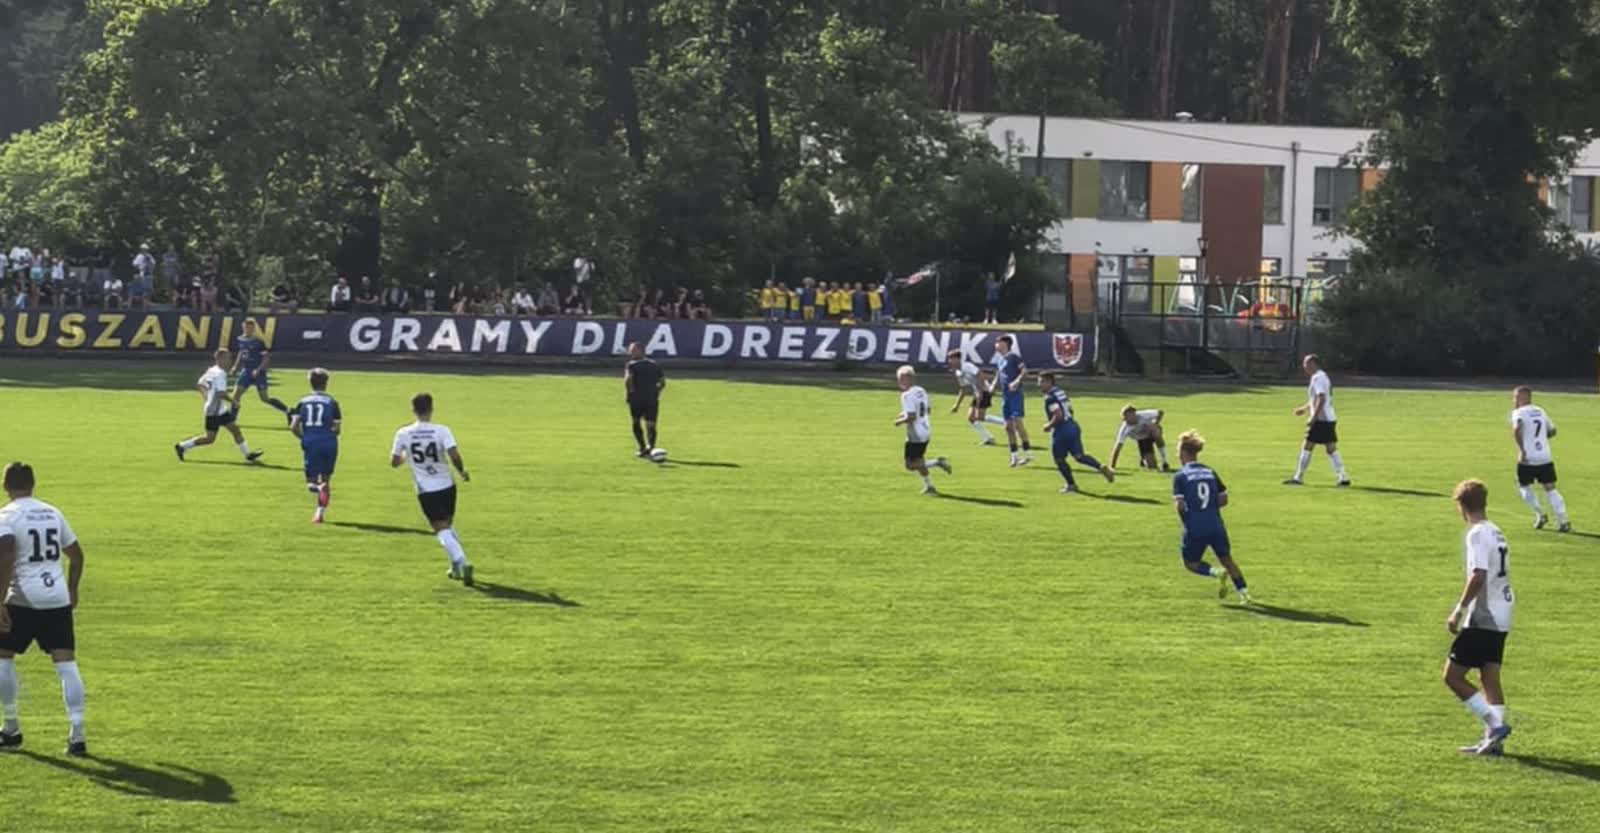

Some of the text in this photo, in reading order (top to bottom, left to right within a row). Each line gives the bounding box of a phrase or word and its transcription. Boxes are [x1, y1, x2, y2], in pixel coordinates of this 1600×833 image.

[0, 312, 277, 349] USZANIN
[302, 330, 322, 339] -
[349, 316, 553, 353] GRAMY
[571, 321, 678, 356] DLA
[1533, 419, 1543, 438] 7
[410, 441, 439, 464] 54
[1197, 481, 1211, 510] 9
[28, 528, 61, 562] 15
